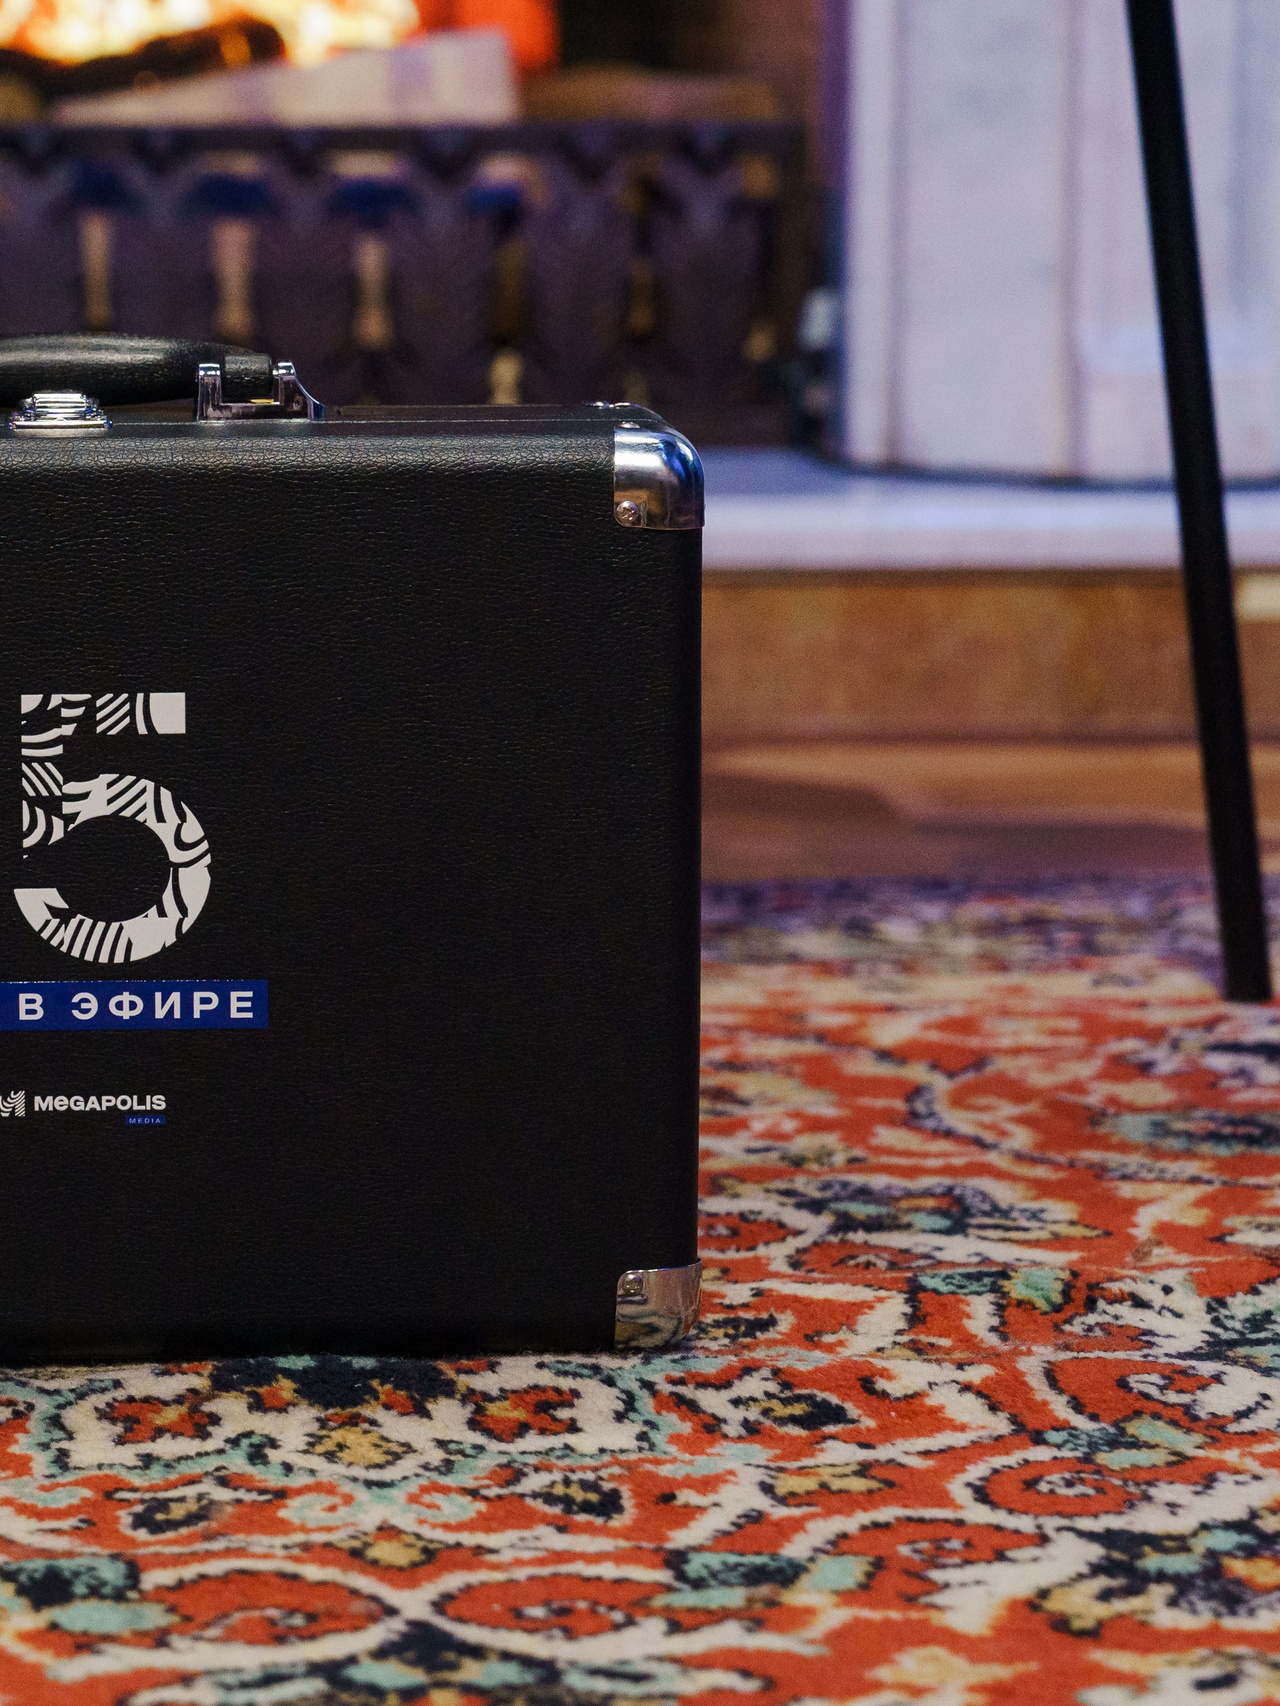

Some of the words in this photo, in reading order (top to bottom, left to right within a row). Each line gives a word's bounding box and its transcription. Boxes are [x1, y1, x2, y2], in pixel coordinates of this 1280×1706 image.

[18, 992, 45, 1021] В
[71, 990, 254, 1020] ЭФИРЕ
[128, 1116, 162, 1125] MEDIA
